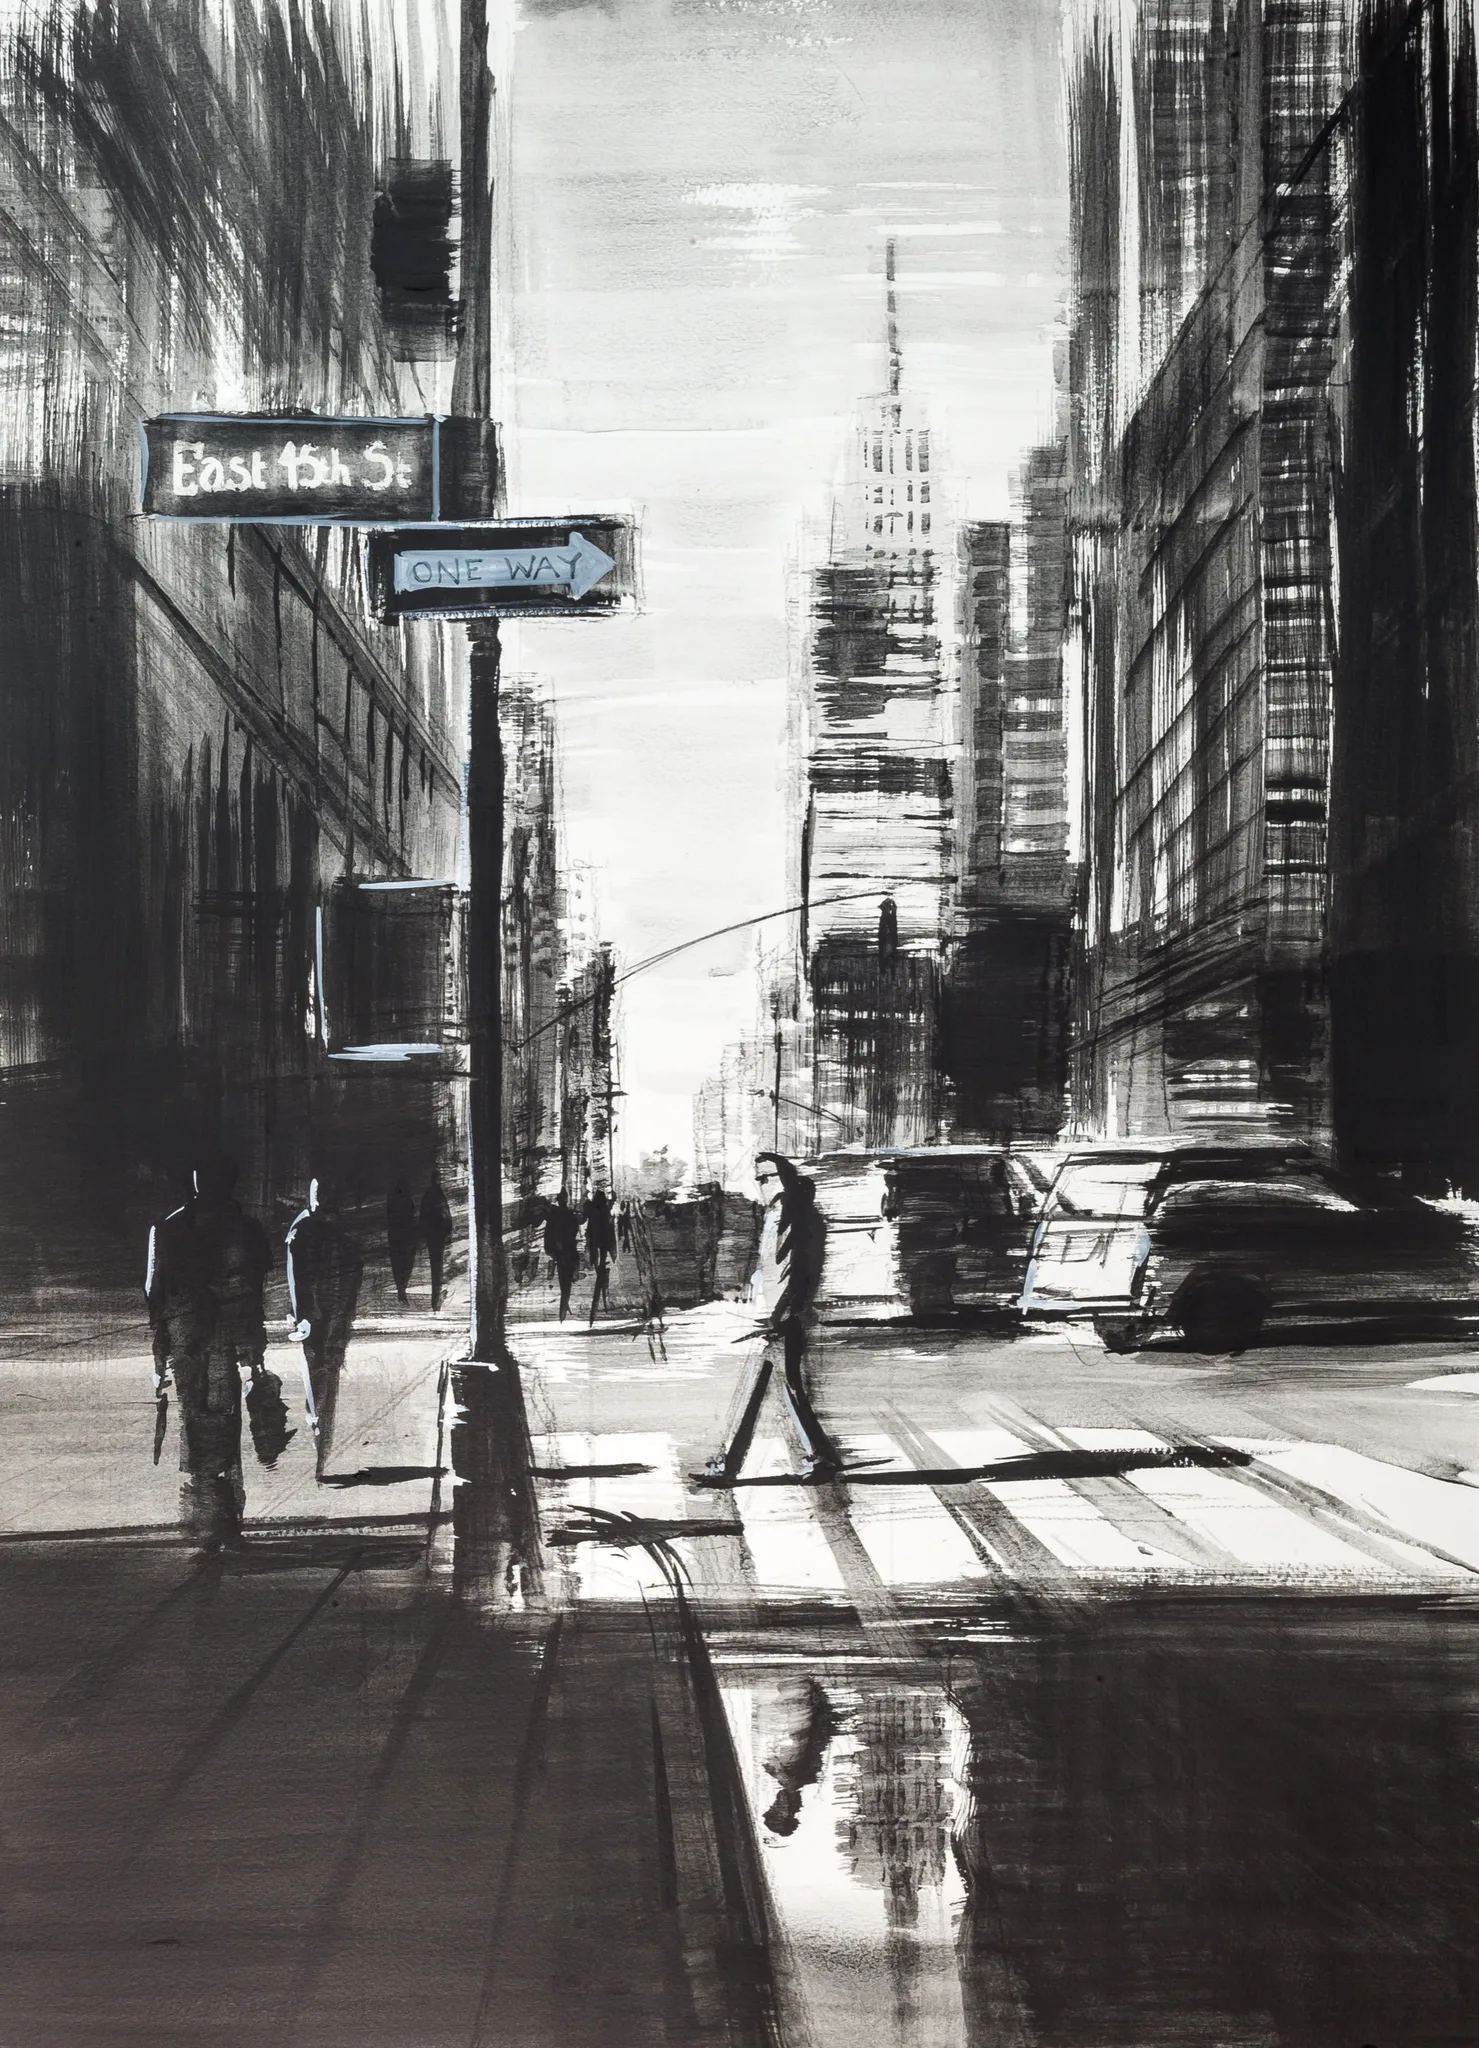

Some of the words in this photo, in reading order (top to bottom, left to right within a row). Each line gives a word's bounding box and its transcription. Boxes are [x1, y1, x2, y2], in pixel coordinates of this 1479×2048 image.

[172, 439, 267, 497] East
[362, 440, 413, 491] St
[412, 557, 484, 585] ONE
[504, 552, 583, 581] WAY
